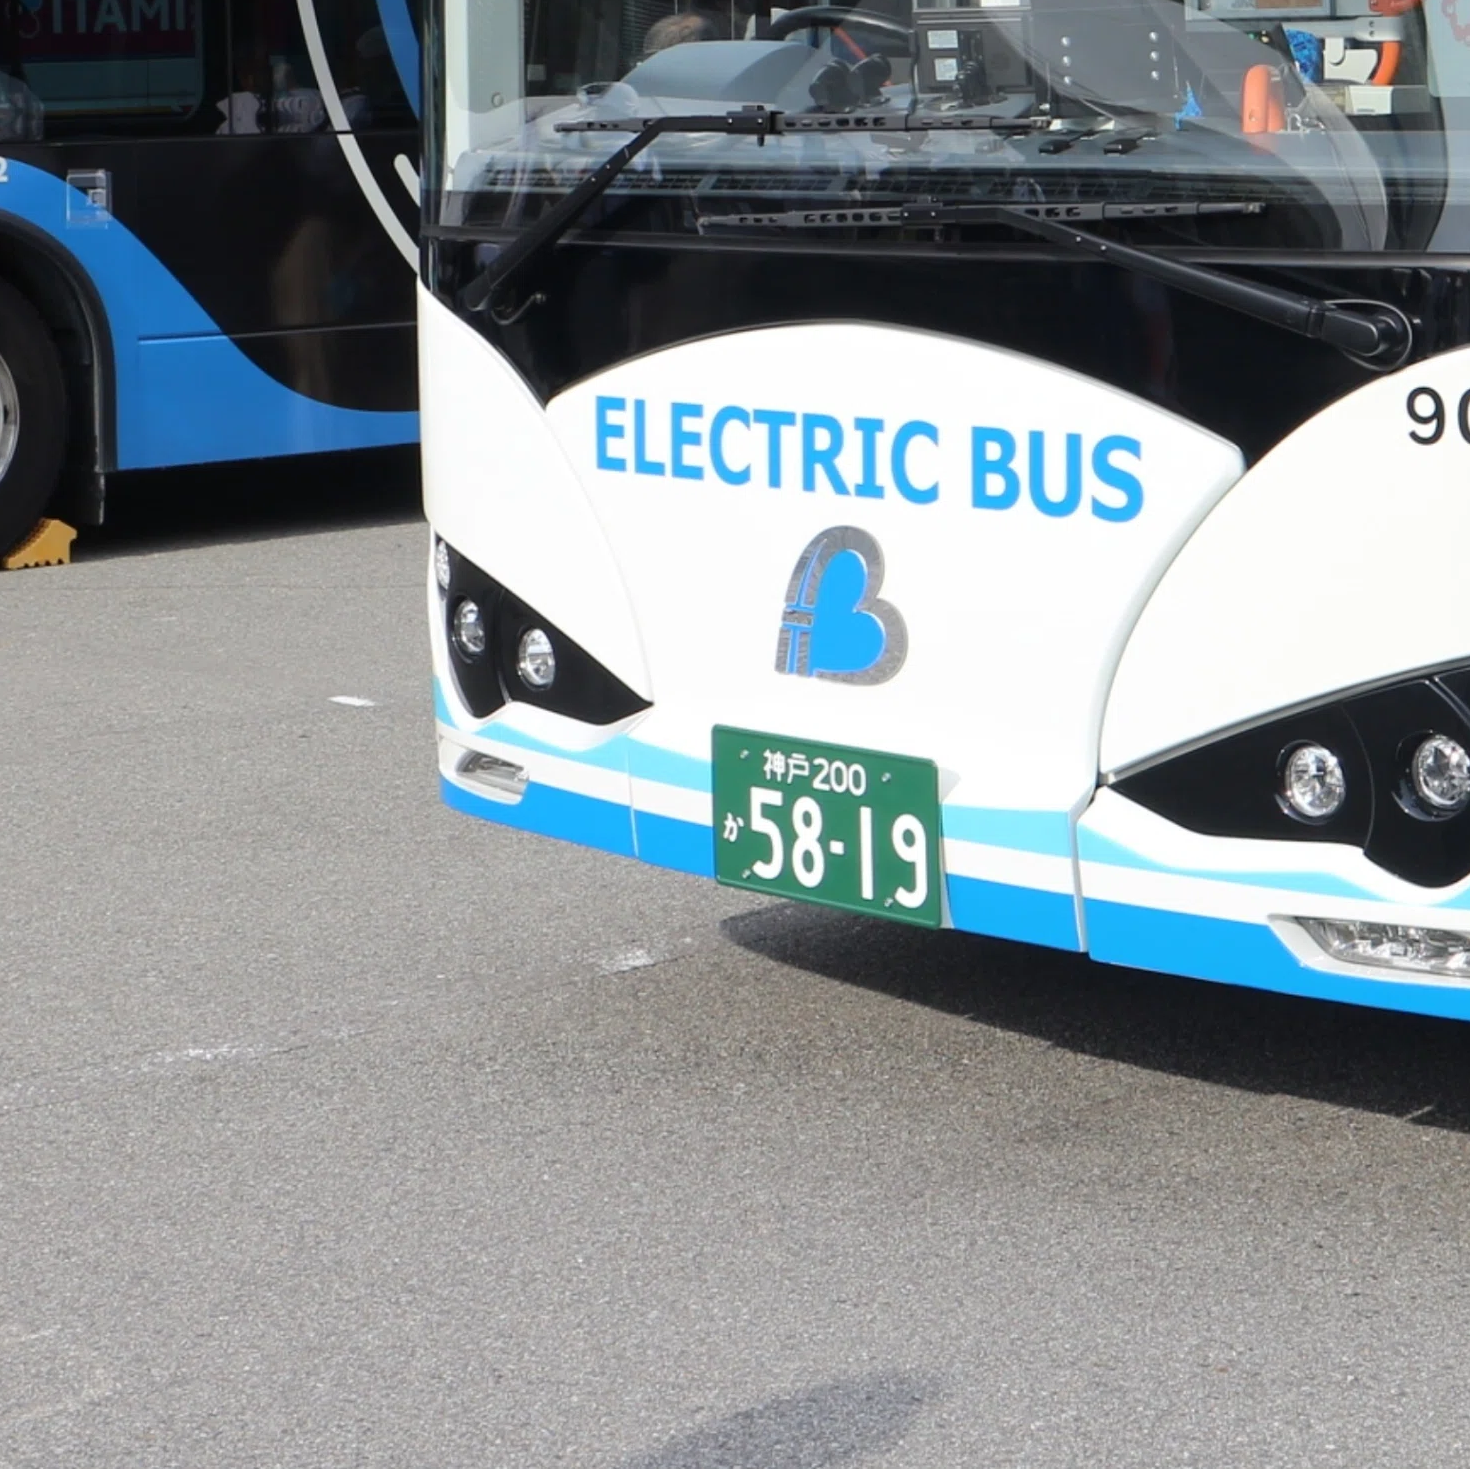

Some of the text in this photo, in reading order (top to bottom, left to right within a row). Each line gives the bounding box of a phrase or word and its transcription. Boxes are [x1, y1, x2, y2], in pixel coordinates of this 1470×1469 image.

[594, 394, 1145, 523] ELECTRIC BUS
[722, 786, 928, 909] か 58-19
